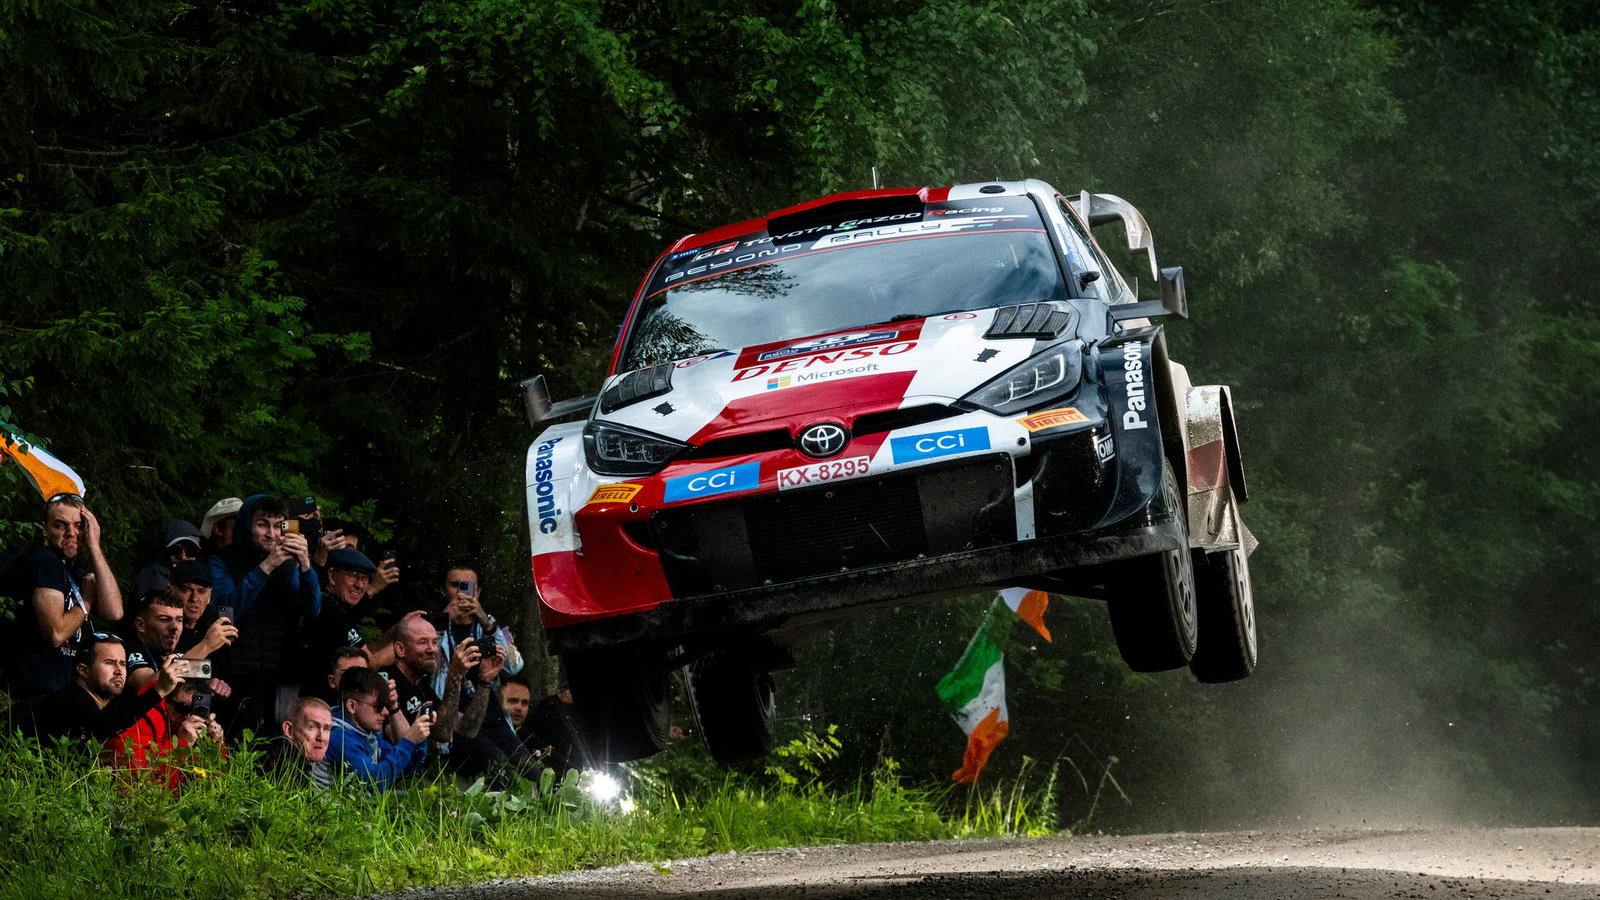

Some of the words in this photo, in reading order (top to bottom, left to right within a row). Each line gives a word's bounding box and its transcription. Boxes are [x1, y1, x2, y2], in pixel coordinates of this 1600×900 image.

[738, 224, 832, 248] TOYOTA
[838, 212, 922, 229] GAZOO
[927, 207, 1004, 217] Racing
[830, 223, 941, 244] RALLY
[696, 245, 735, 261] GR
[730, 342, 918, 384] DENSO
[798, 363, 879, 383] Microsoft
[1023, 410, 1083, 429] PIRELLI
[779, 457, 870, 488] KX-8295
[535, 437, 564, 534] Panasonic
[589, 486, 636, 501] PIRELLI
[347, 628, 359, 641] 42
[128, 652, 145, 663] 42
[407, 696, 422, 711] 42
